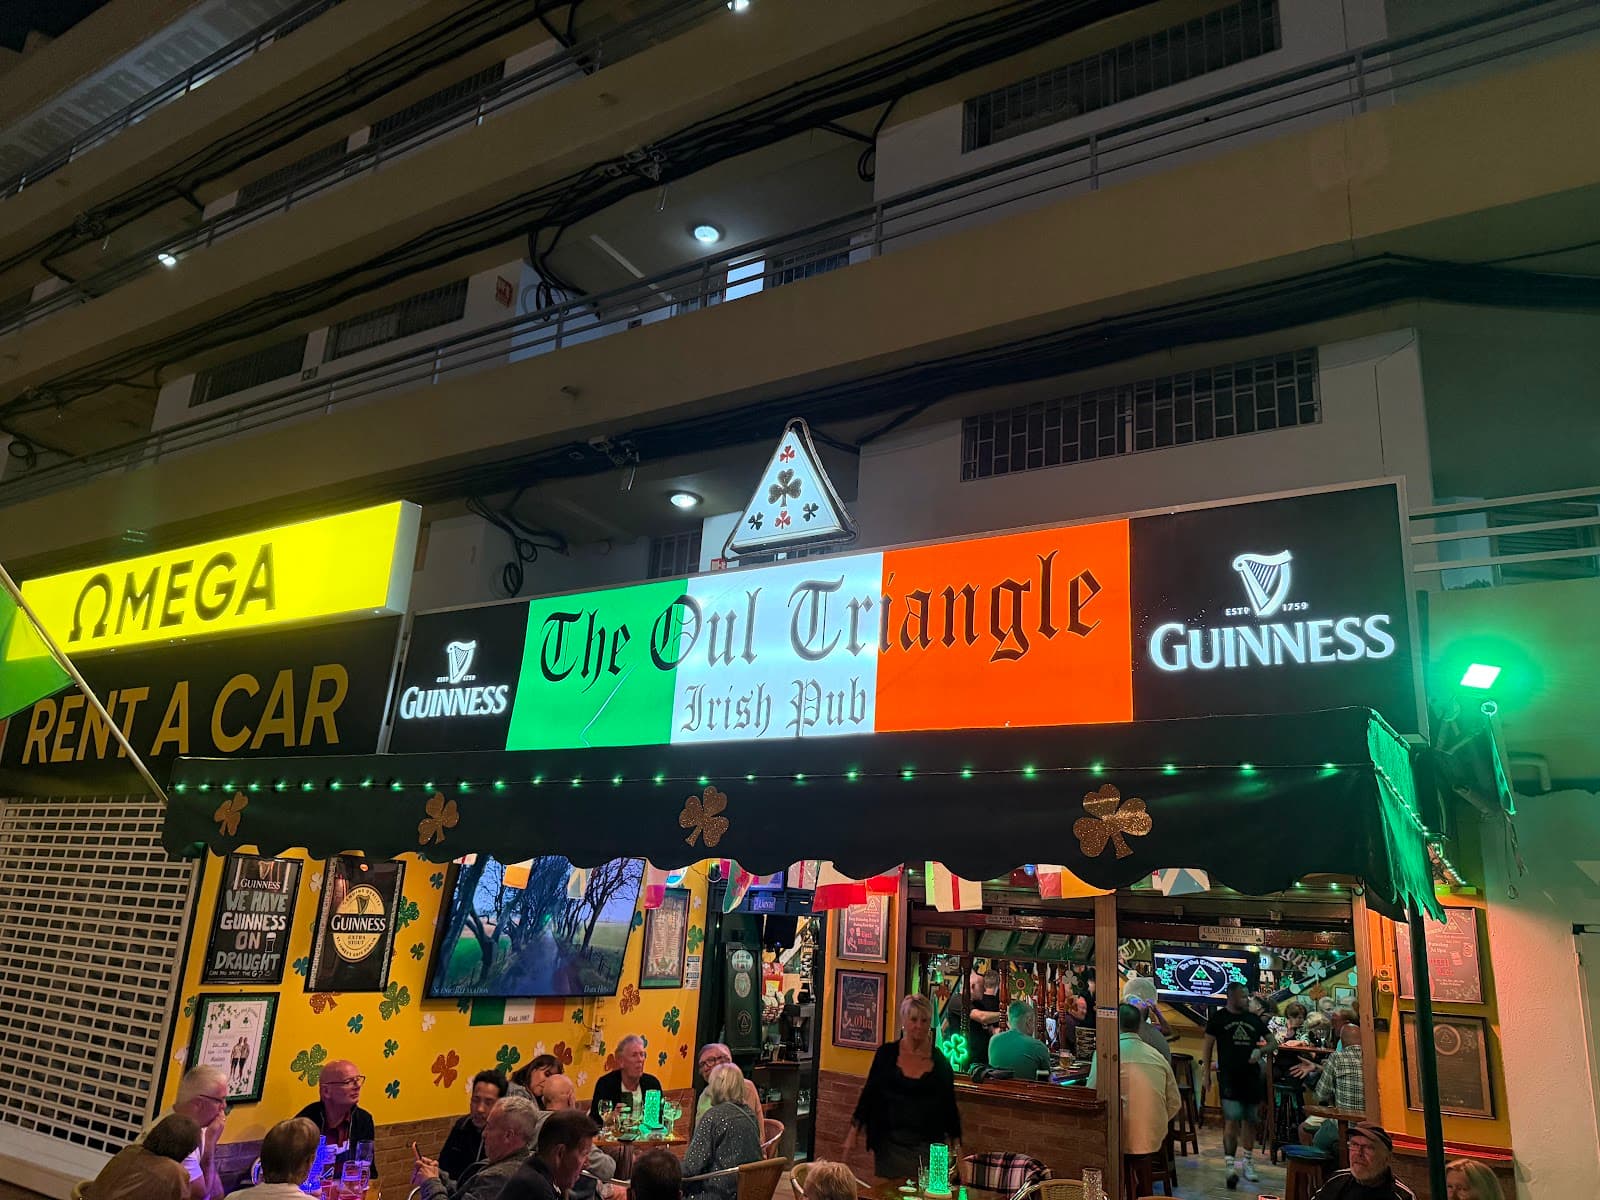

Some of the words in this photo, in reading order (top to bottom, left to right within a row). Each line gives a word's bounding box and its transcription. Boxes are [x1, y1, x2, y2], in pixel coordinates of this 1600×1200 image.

[1281, 601, 1309, 612] 1759
[540, 609, 631, 693] The
[650, 588, 762, 671] Oul
[788, 549, 1102, 664] Triangle
[1149, 613, 1396, 672] GUINNESS
[400, 685, 509, 719] GUINNESS
[681, 680, 774, 737] Irish
[788, 676, 867, 738] Pub
[21, 686, 151, 765] RENT
[151, 680, 190, 757] A
[211, 663, 349, 752] CAR
[240, 878, 281, 890] GUINNESS
[226, 890, 249, 912] WE
[250, 891, 288, 913] HAVE
[220, 911, 287, 931] GUINNESS
[331, 914, 387, 932] GUINNESS
[235, 931, 261, 950] ON
[214, 951, 281, 971] DRAUGHT
